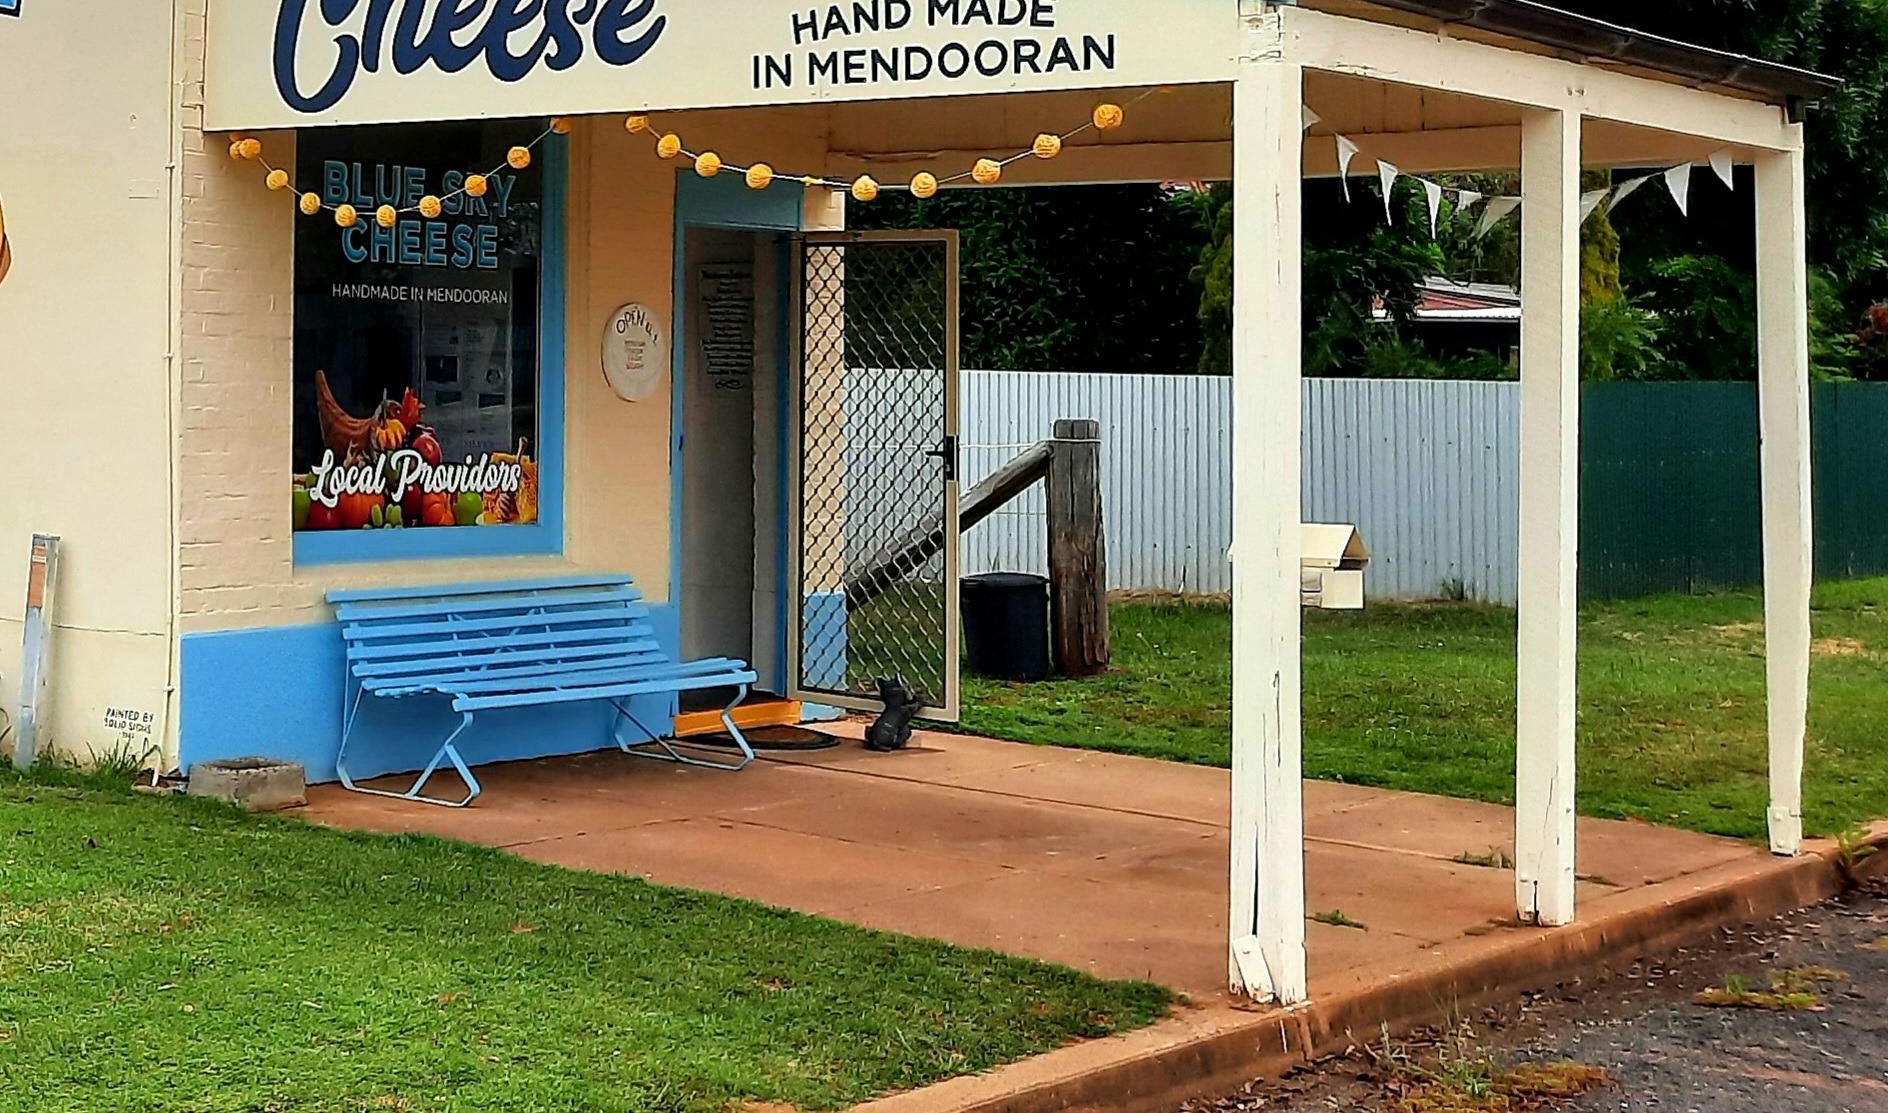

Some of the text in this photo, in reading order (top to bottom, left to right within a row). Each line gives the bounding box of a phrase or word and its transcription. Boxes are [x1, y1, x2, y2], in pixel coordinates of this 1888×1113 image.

[753, 34, 1115, 89] IN MENDOORAN
[323, 160, 426, 208] BLUE
[342, 217, 498, 268] CHEESE
[332, 283, 508, 304] HANDMADE IN MENDOORAN
[310, 448, 386, 508] Local
